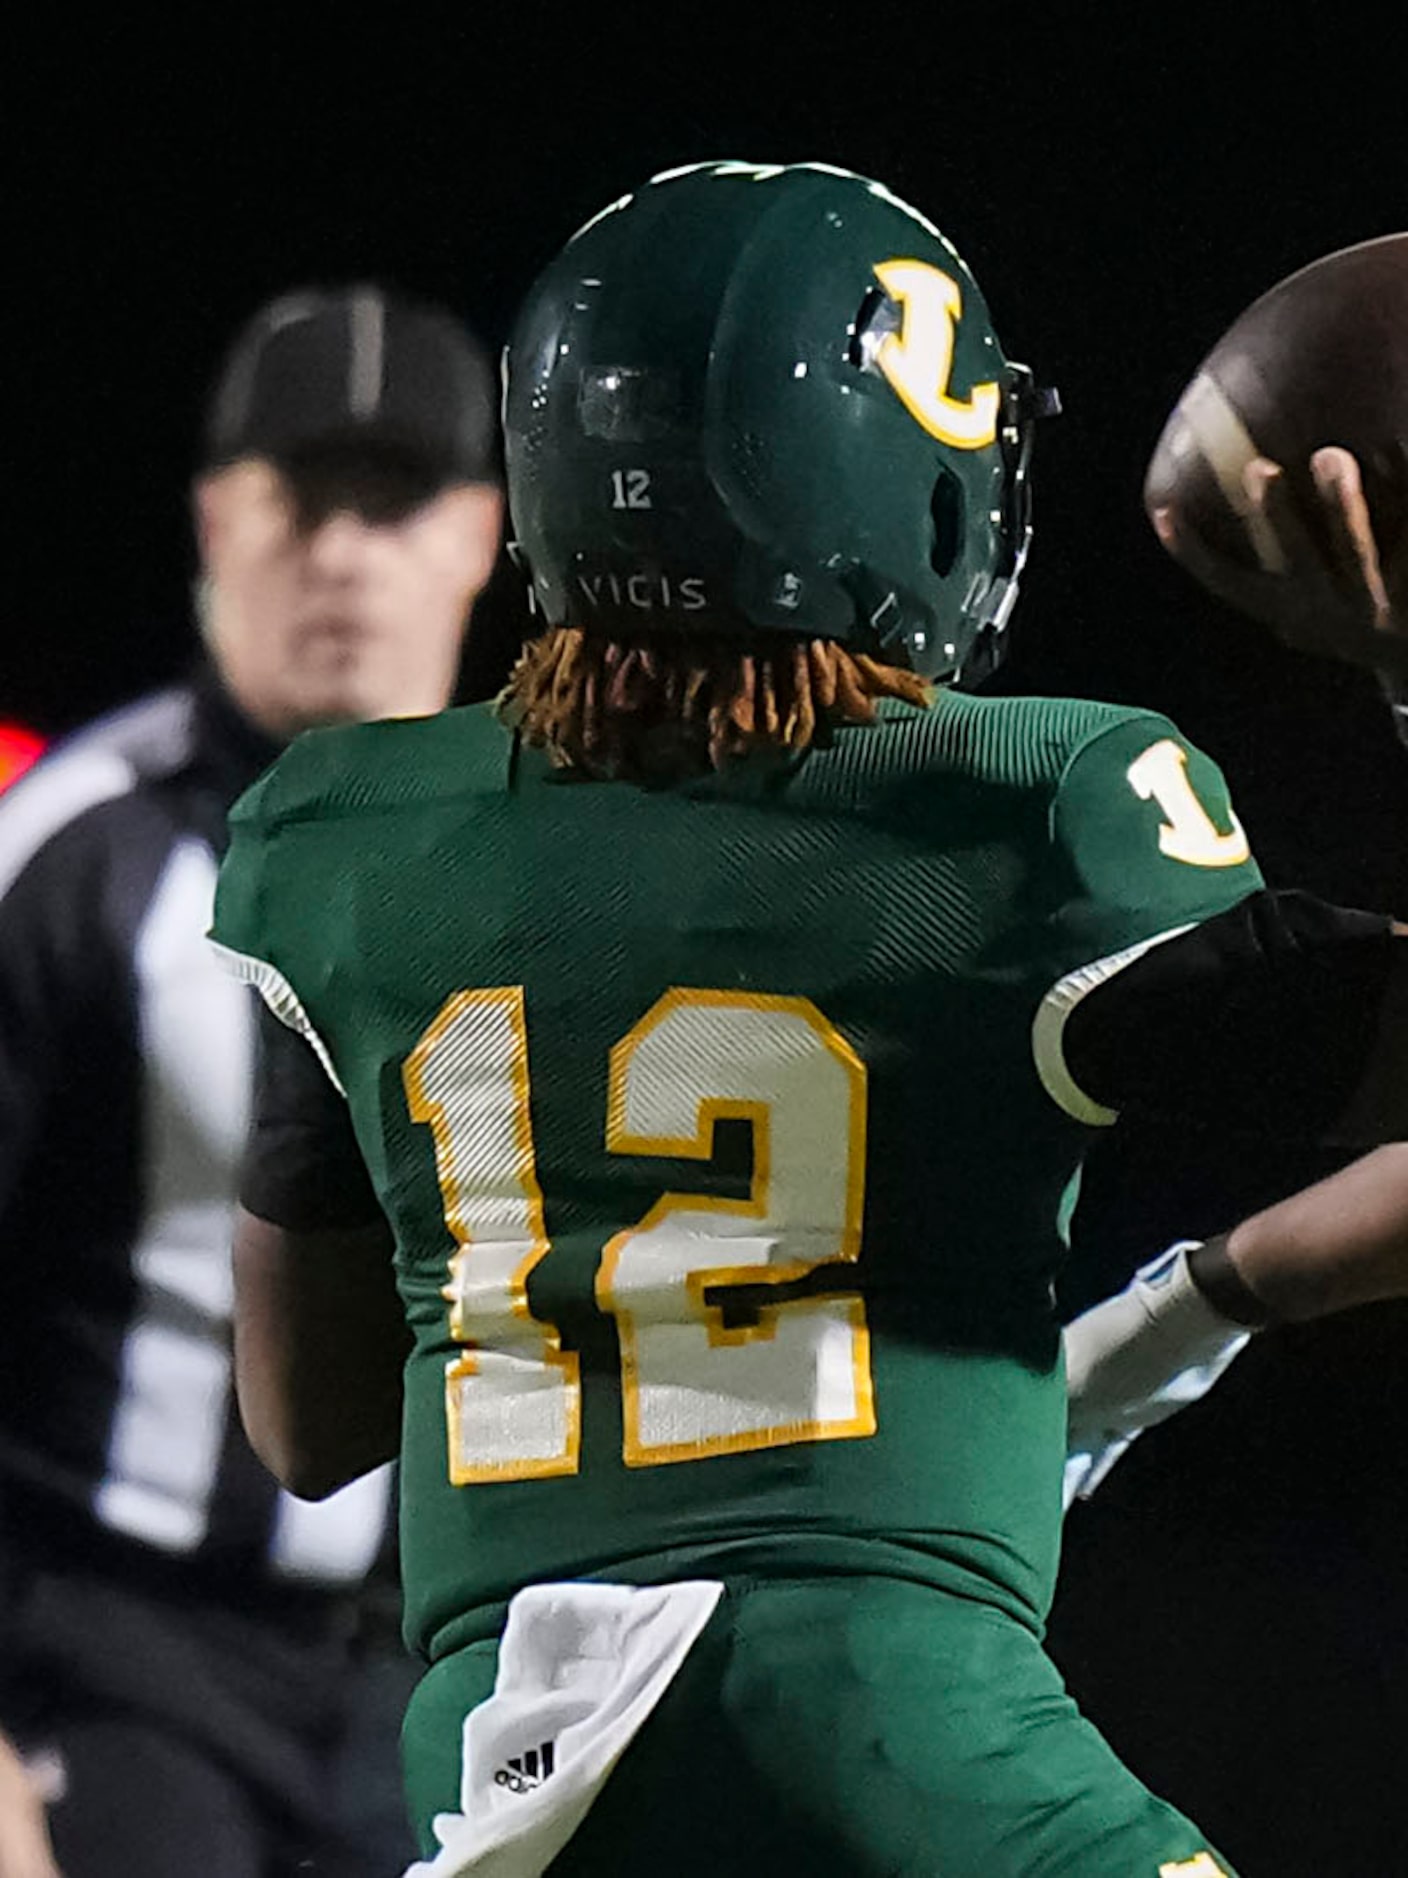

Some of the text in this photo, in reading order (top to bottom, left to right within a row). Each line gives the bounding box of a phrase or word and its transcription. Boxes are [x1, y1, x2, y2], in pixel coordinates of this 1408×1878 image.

[873, 258, 998, 450] L
[612, 469, 651, 509] 12
[578, 574, 707, 610] VICIS
[1126, 738, 1250, 868] L
[402, 985, 877, 1486] 12
